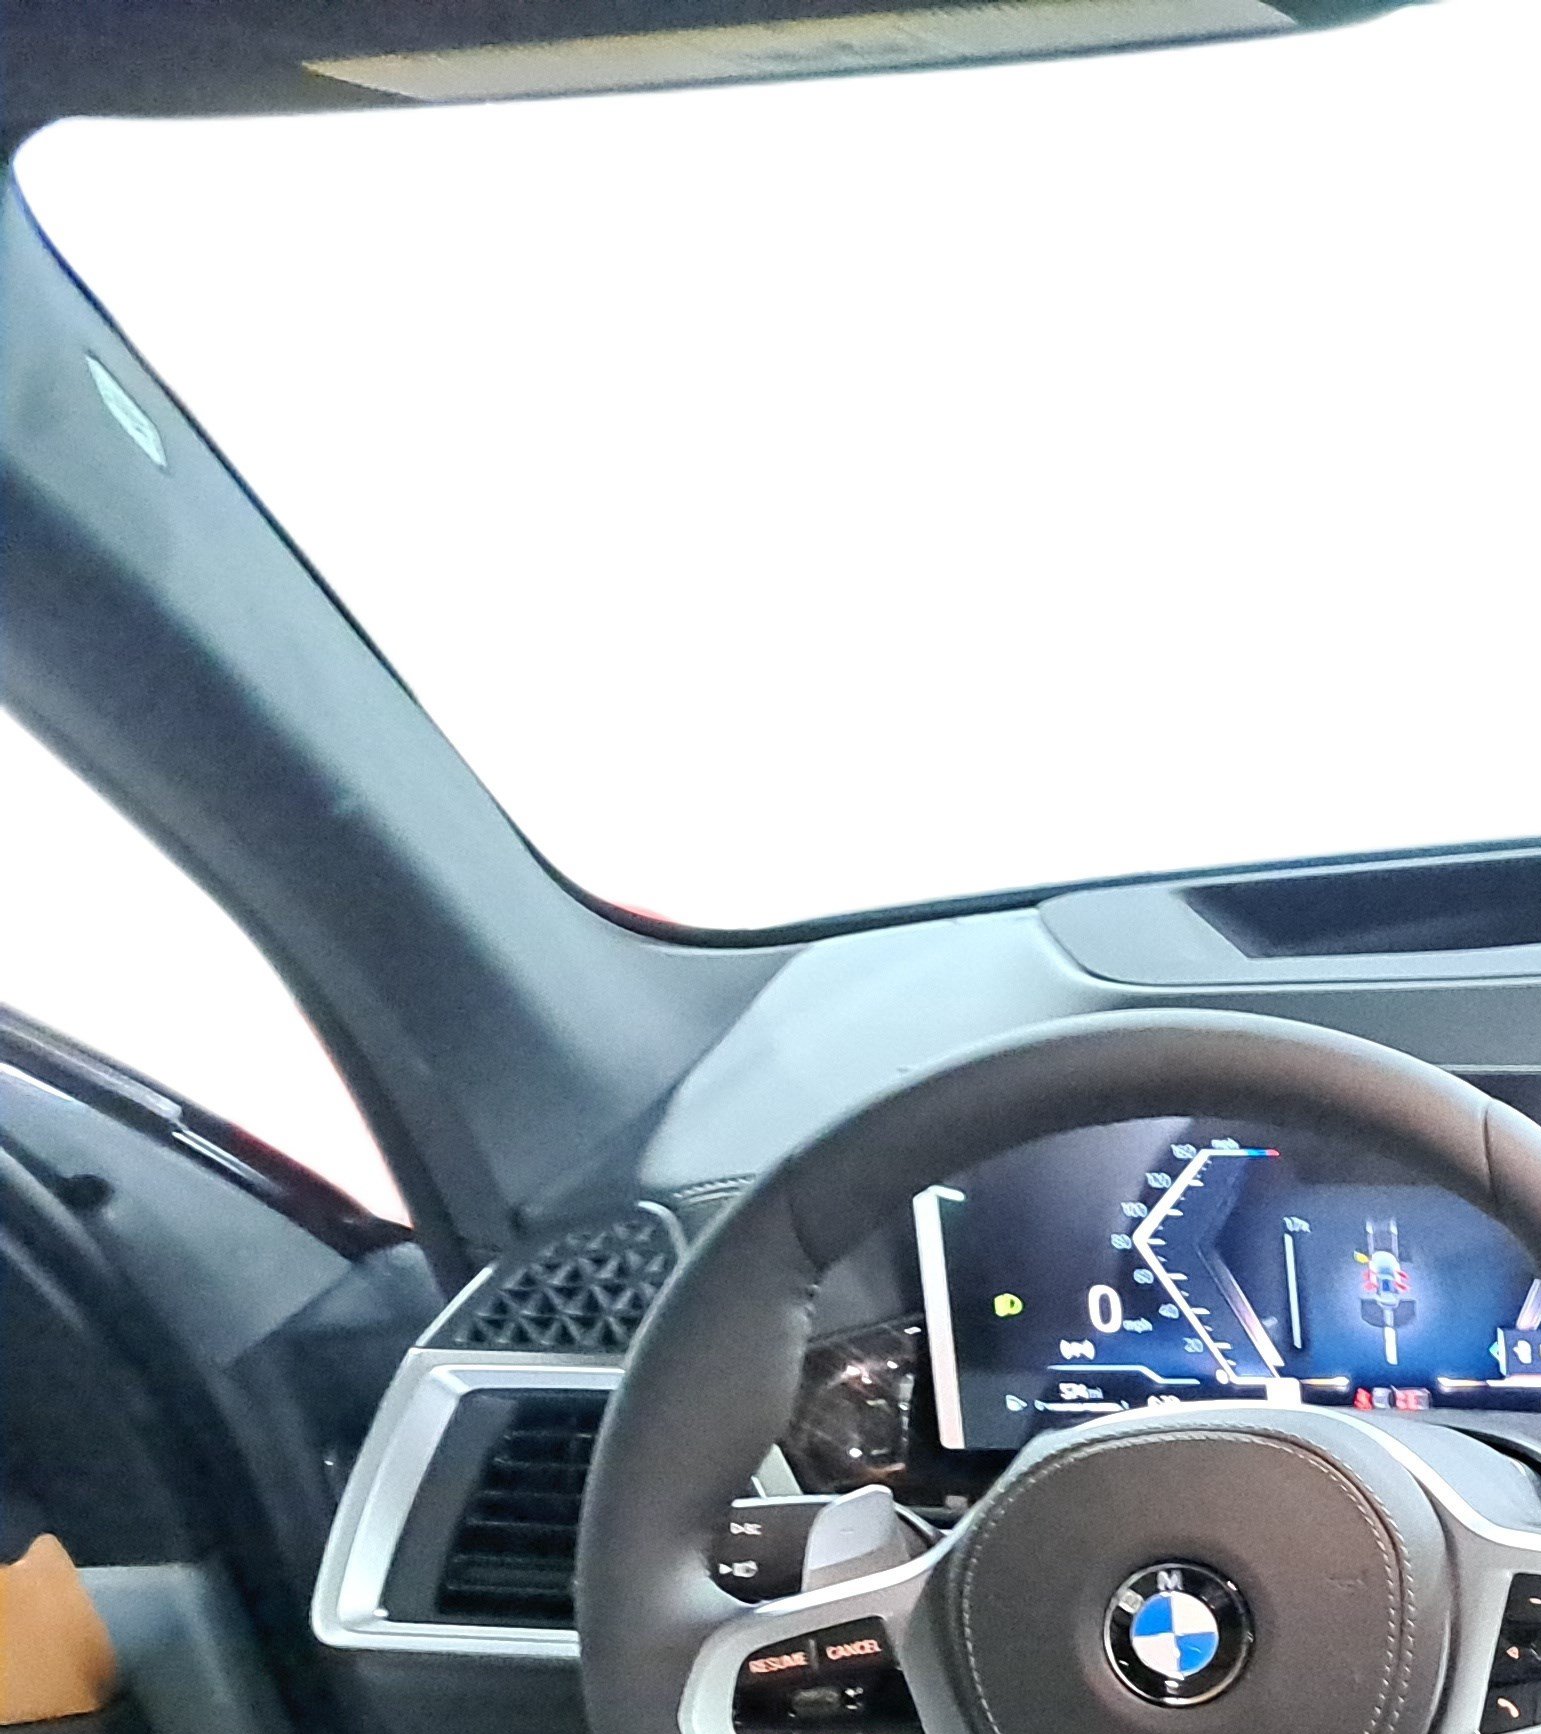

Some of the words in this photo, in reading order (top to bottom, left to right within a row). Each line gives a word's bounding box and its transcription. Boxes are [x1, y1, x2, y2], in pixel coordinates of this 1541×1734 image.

[1087, 1283, 1123, 1334] 0
[825, 1638, 882, 1661] CANCEL
[748, 1651, 809, 1674] RESUME
